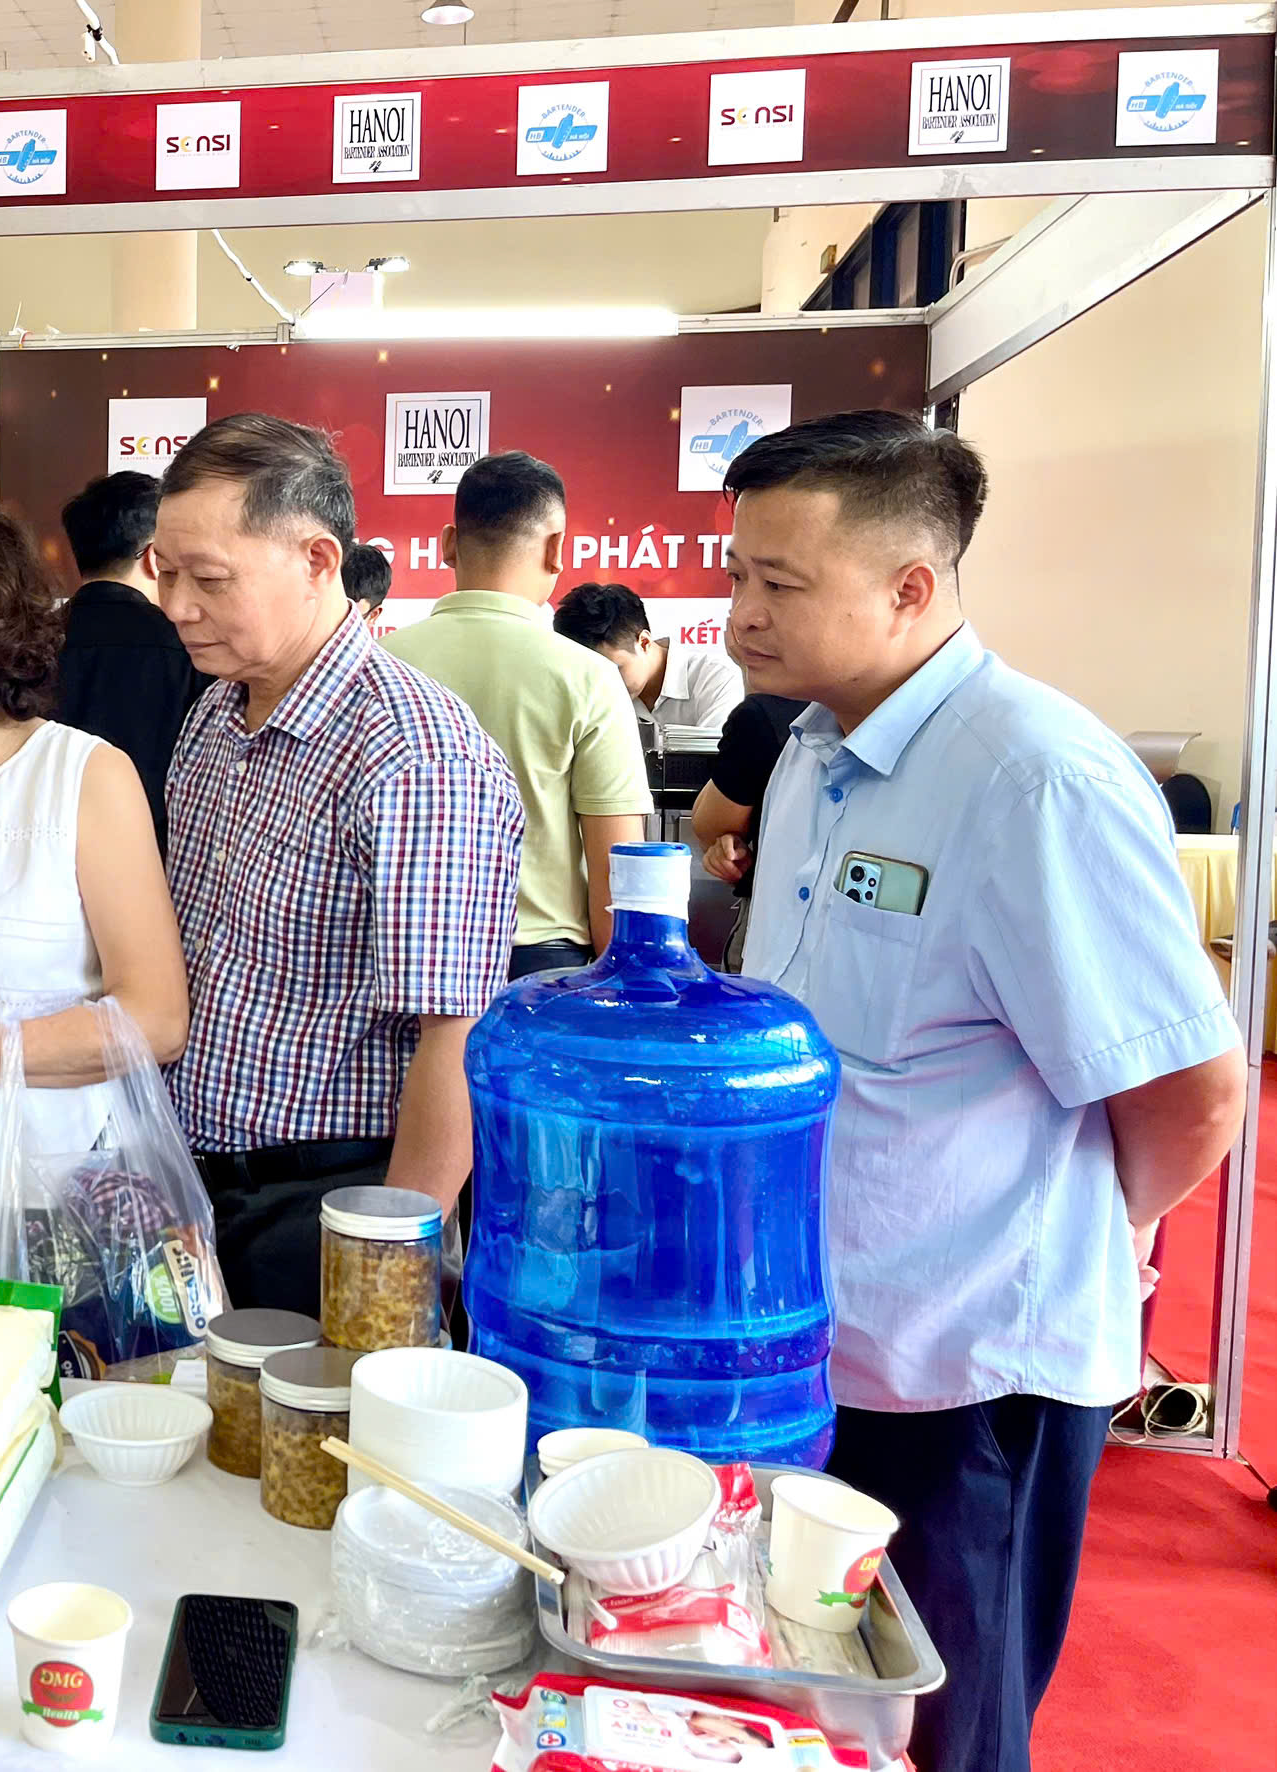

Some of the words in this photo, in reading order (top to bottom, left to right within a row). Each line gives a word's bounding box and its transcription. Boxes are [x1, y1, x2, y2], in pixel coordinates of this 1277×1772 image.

[928, 73, 992, 113] HANOI
[348, 107, 407, 144] HANOI
[922, 115, 958, 130] BARTENDER
[959, 112, 998, 128] ASSOCIATION
[6, 129, 46, 144] BARTENDER
[344, 146, 376, 160] BARTENDER
[377, 144, 411, 158] ASSOCIATION
[709, 408, 764, 426] BARTENDER
[404, 407, 472, 449] HANOI
[119, 435, 197, 456] SENS
[694, 441, 710, 450] HB
[397, 452, 435, 467] BARTENDER
[436, 451, 477, 467] ASSOCIATION
[573, 524, 686, 569] PHÁT
[679, 618, 721, 645] KẾT
[39, 1668, 84, 1689] DMG
